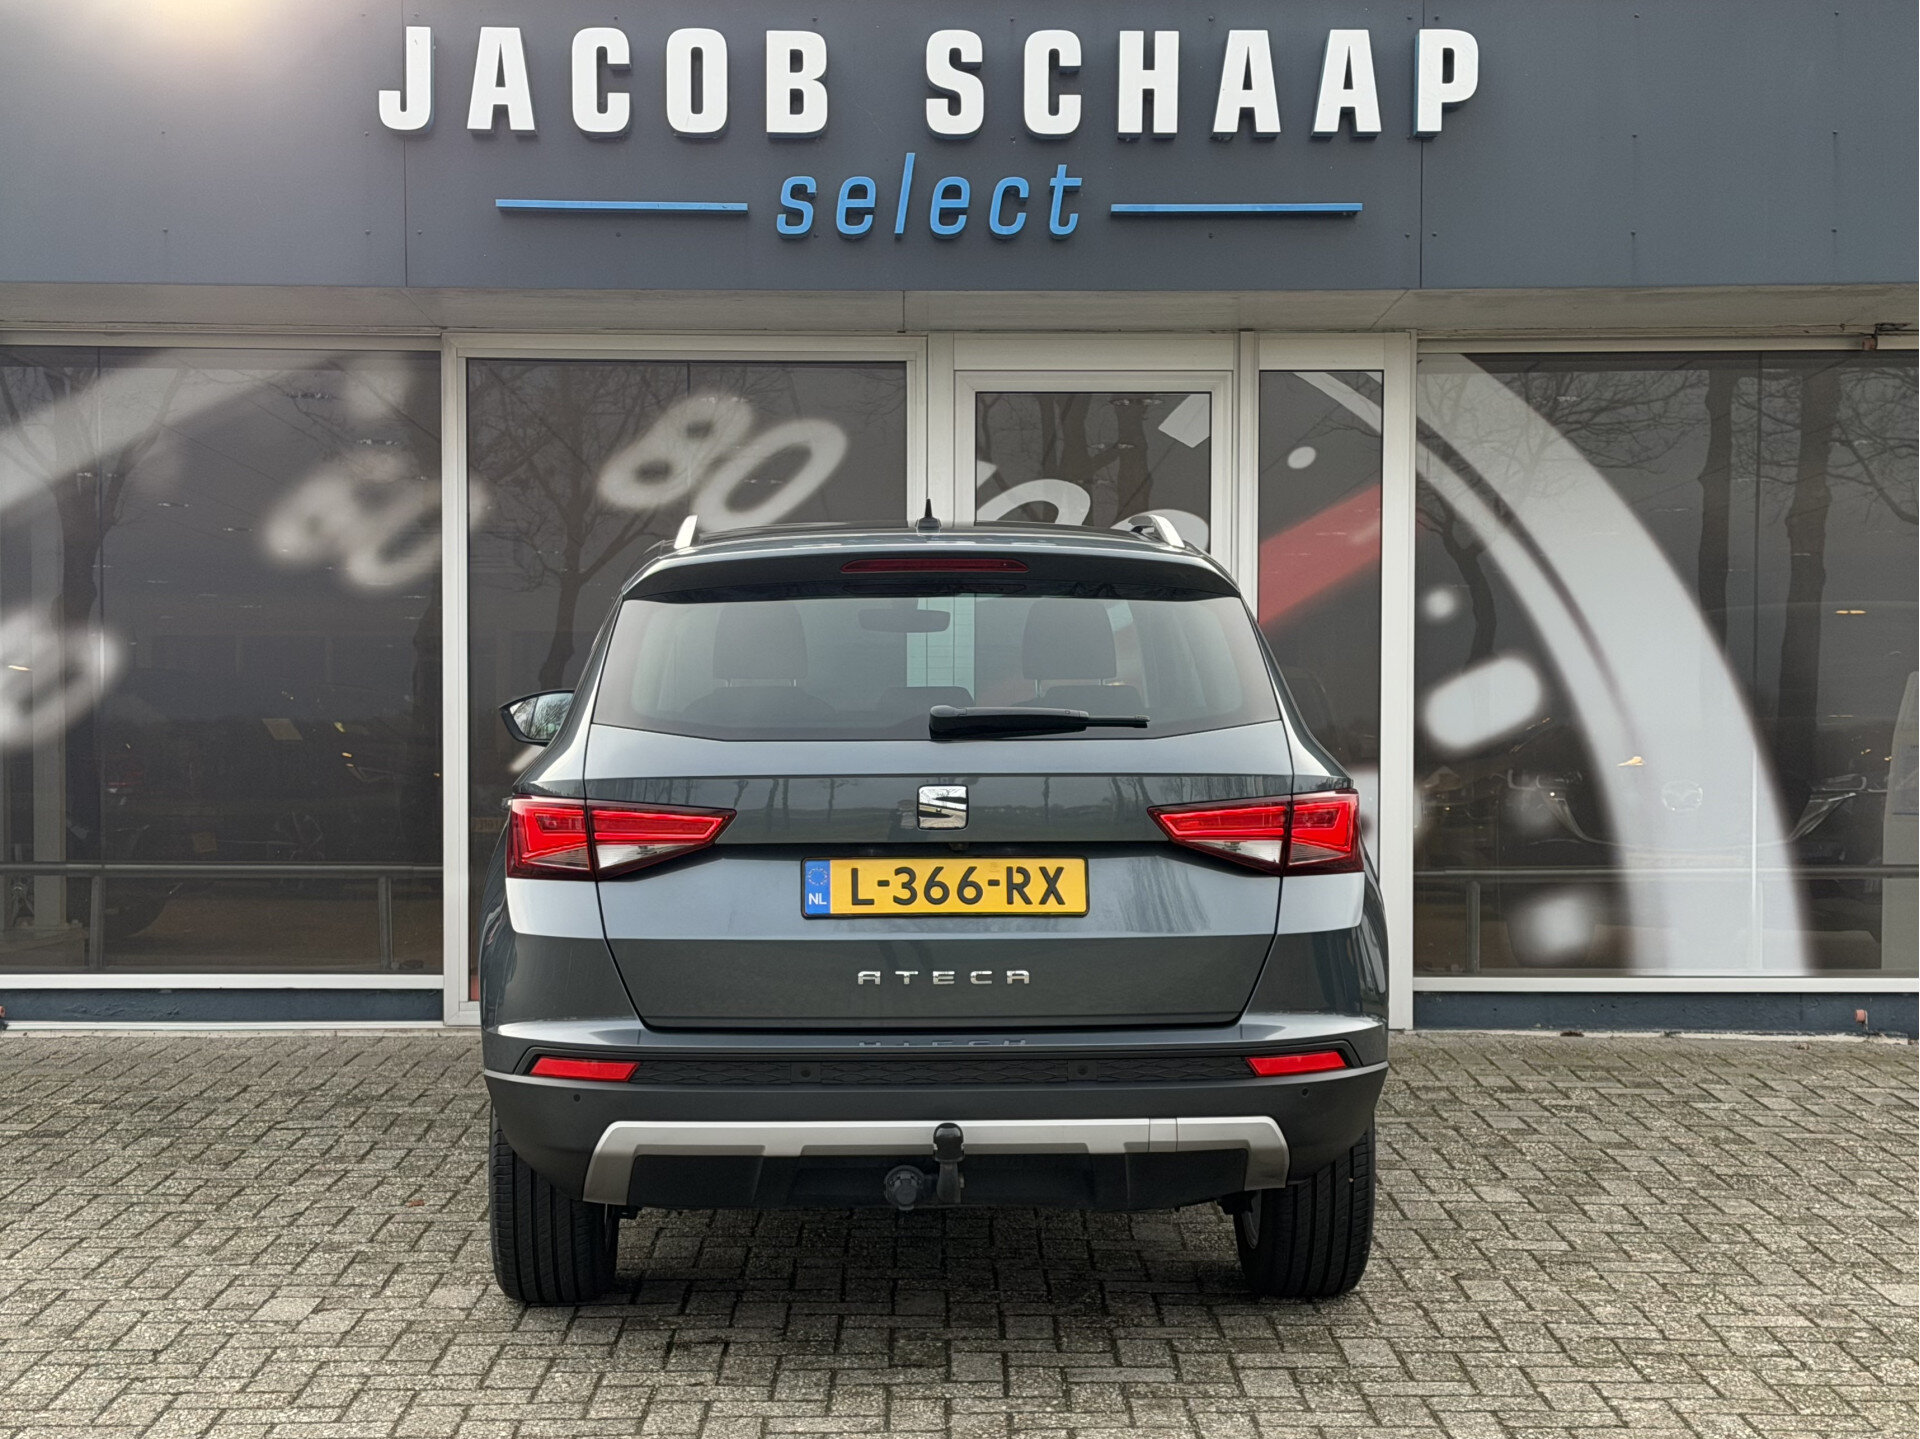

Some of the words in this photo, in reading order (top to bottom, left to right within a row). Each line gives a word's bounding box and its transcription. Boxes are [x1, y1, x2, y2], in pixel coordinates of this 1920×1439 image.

[378, 26, 829, 138] JACOB
[925, 28, 1480, 138] SCHAAP
[776, 152, 1083, 237] select
[808, 893, 827, 905] NL
[850, 866, 1067, 906] L-366-RX
[857, 970, 1031, 985] ATECA
